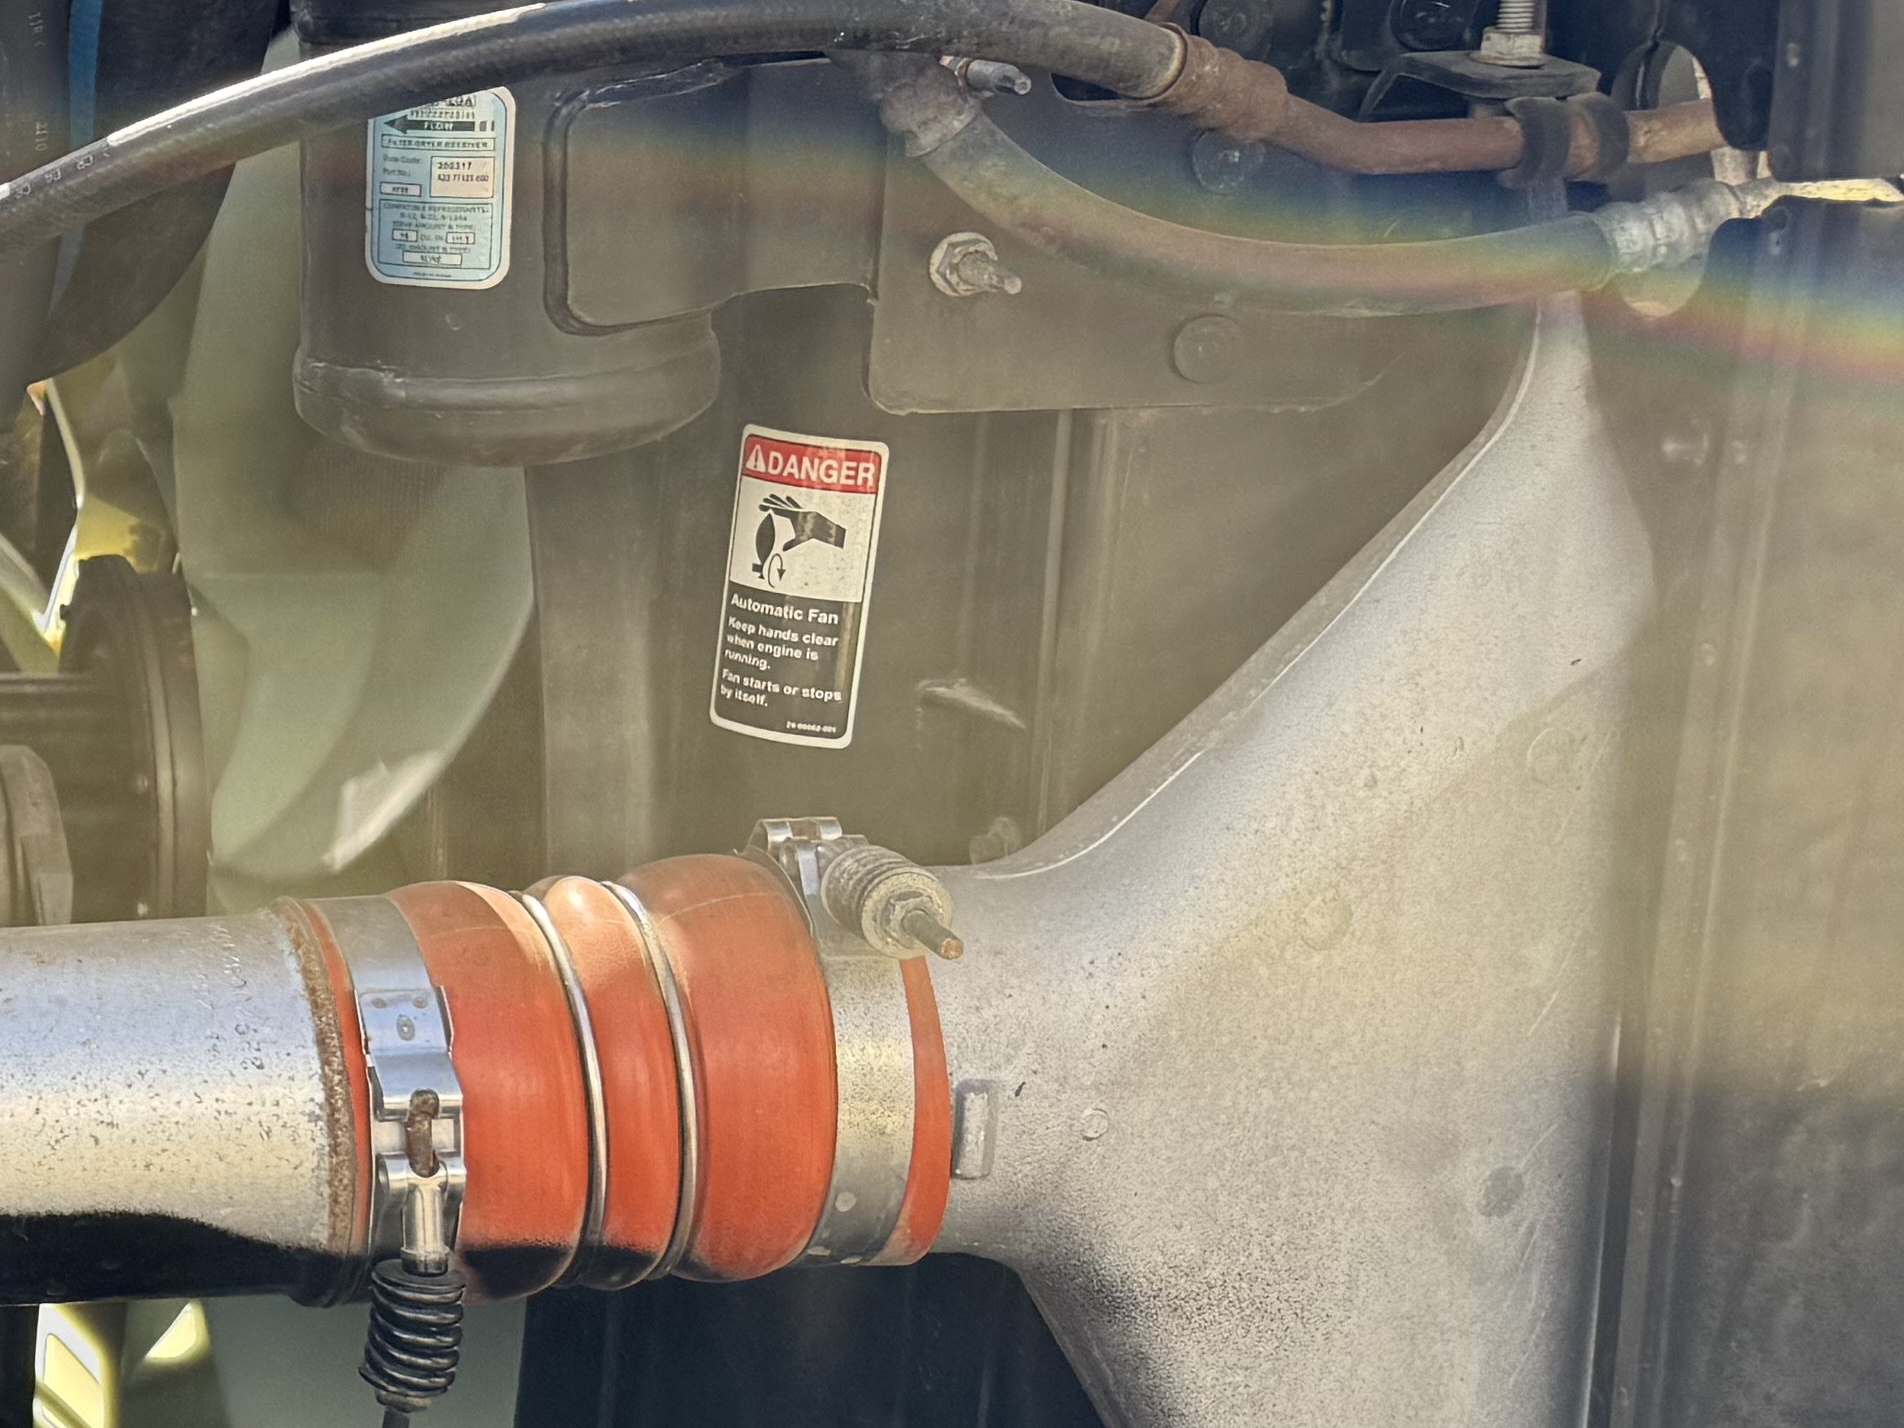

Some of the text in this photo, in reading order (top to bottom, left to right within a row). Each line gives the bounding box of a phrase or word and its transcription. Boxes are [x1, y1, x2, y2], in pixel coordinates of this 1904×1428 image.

[767, 450, 876, 487] DANGER
[731, 593, 839, 625] Automatic Fan
[728, 616, 838, 647] Keep hands clear
[724, 649, 771, 671] running.
[726, 634, 819, 661] when engine is
[720, 684, 768, 707] by itself.
[722, 668, 842, 702] Fan starts or stops
